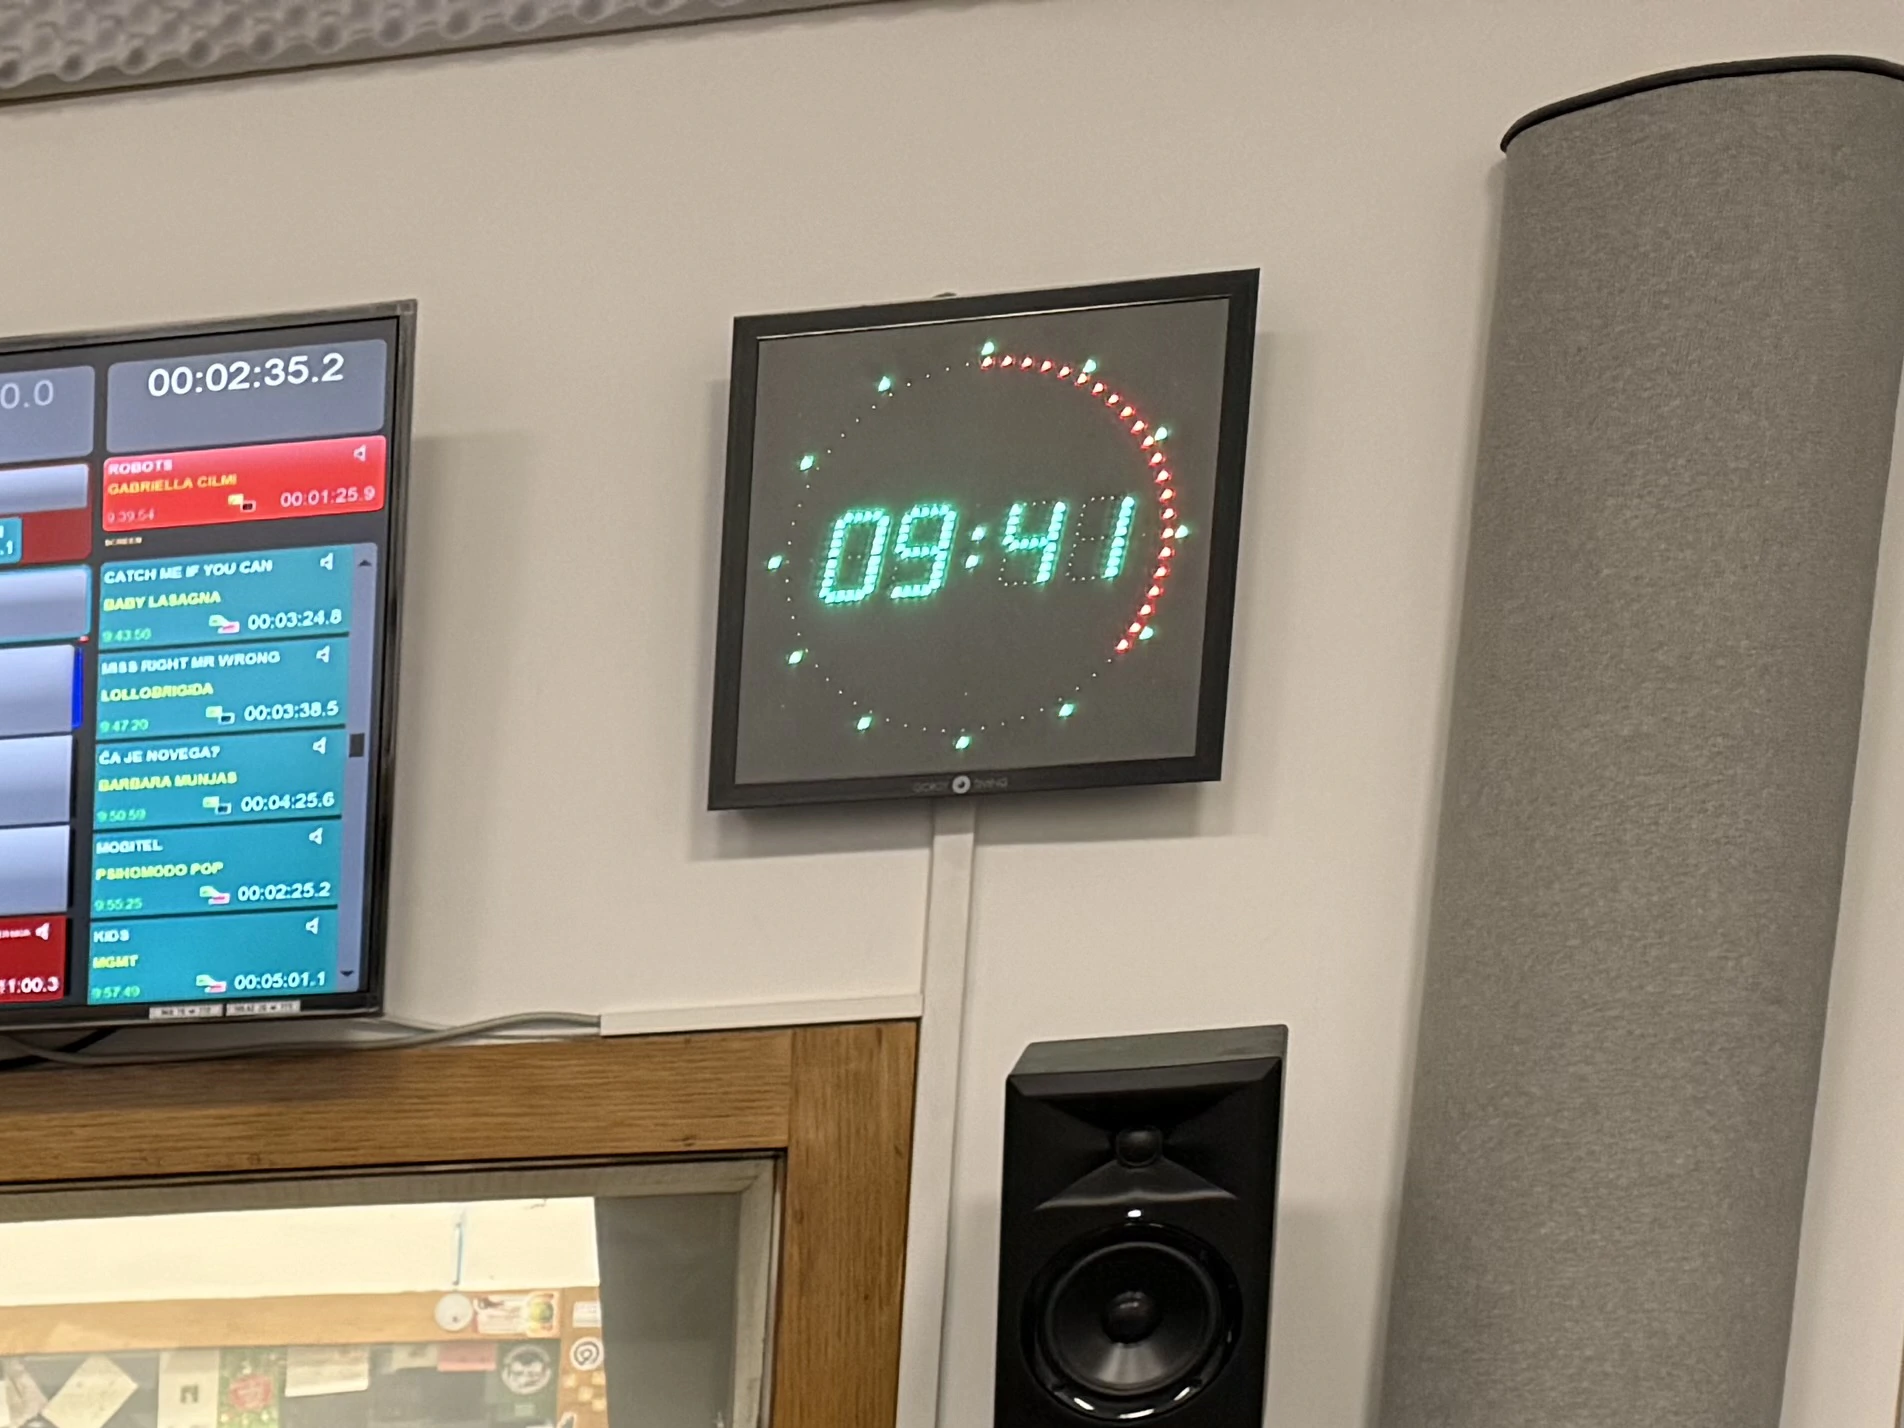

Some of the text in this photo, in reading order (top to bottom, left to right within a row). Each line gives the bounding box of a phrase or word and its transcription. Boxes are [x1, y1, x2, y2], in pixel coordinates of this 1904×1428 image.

[148, 352, 344, 397] 00:02:35.2
[107, 459, 173, 475] ROBOTS
[107, 477, 193, 495] GABRIELLA
[280, 486, 376, 508] 00:01:25.9
[819, 496, 1135, 606] 09:41
[103, 559, 273, 584] CATCH ME IF YOU CAN
[103, 591, 221, 612] BABY LASAGNA
[247, 609, 342, 631] 00:03:24.8
[101, 651, 280, 675] MISS RIGHT MR WRONG
[100, 682, 213, 703] LOLLOBRIGIDA
[243, 700, 339, 722] 00:03:38.5
[123, 749, 142, 764] JE
[145, 745, 220, 762] NOVEGA?
[98, 775, 172, 793] BARBARA
[241, 791, 335, 812] 00:04:25.6
[96, 861, 224, 881] PSIHOMODO POP
[238, 881, 331, 902] 00:02:25.2
[94, 928, 130, 944] KIDS
[234, 970, 326, 991] 00:05:01.1
